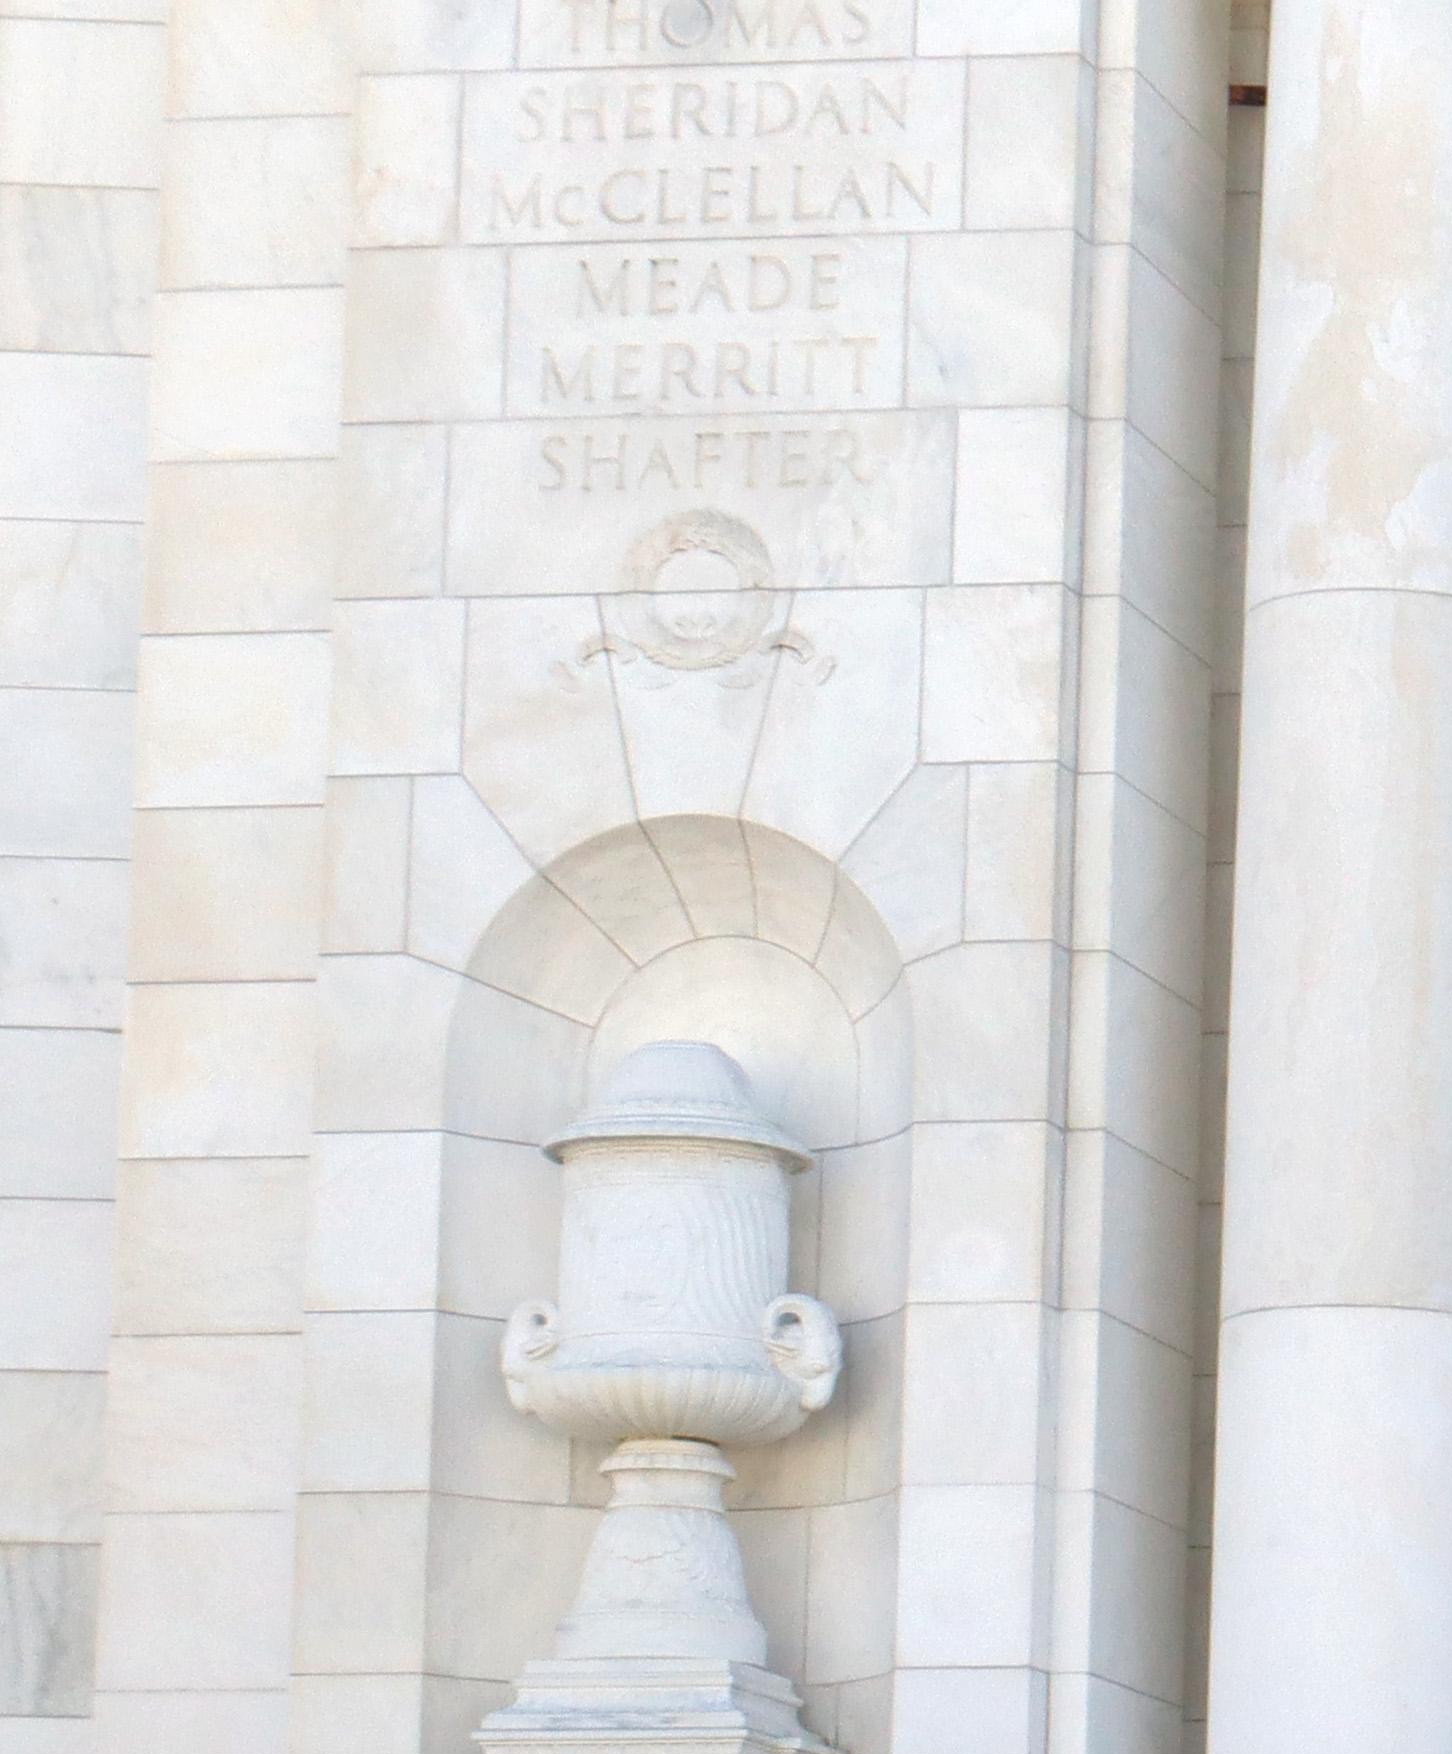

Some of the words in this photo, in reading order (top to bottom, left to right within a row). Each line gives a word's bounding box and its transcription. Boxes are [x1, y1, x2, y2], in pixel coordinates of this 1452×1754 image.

[565, 0, 873, 54] THOMAS
[516, 76, 908, 144] SHERIDAN
[575, 253, 841, 319] MEADE
[539, 336, 878, 402] MERRITT
[538, 429, 876, 493] SHAFTER
